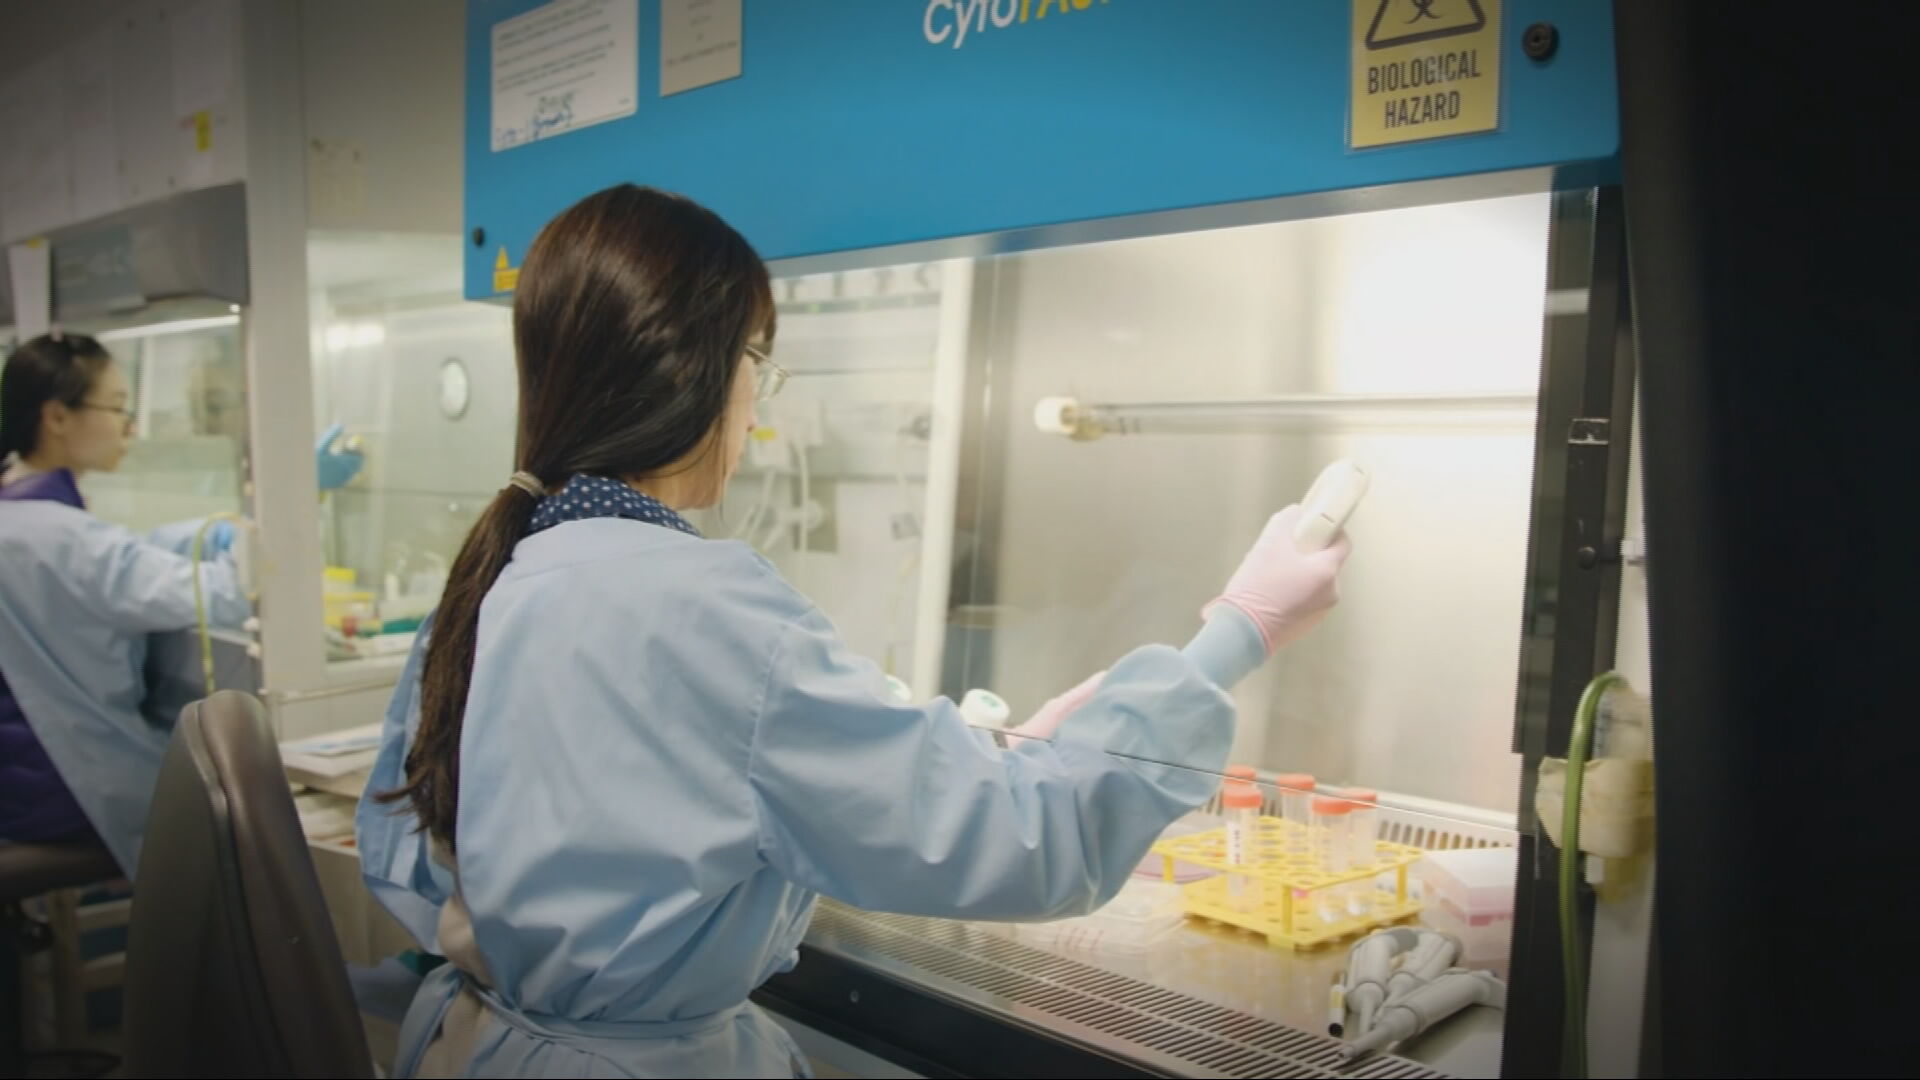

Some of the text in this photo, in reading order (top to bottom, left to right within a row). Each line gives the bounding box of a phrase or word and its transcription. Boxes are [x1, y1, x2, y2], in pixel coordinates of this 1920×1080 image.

[923, 0, 1109, 49] Cyto
[1367, 49, 1482, 95] BIOLOGICAL
[1385, 90, 1460, 129] HAZARD
